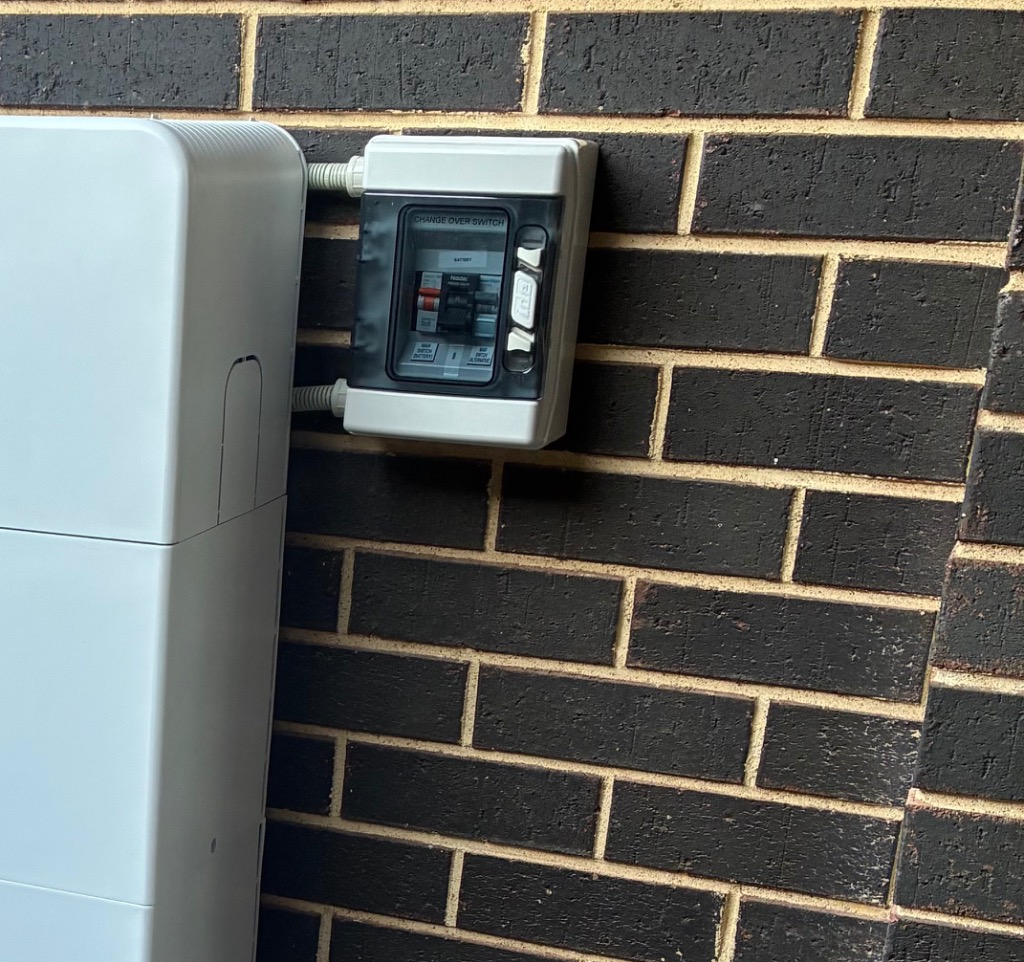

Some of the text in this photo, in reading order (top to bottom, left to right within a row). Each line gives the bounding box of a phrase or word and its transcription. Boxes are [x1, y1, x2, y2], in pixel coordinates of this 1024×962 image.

[414, 216, 504, 227] CHANGE OVER SWITCH
